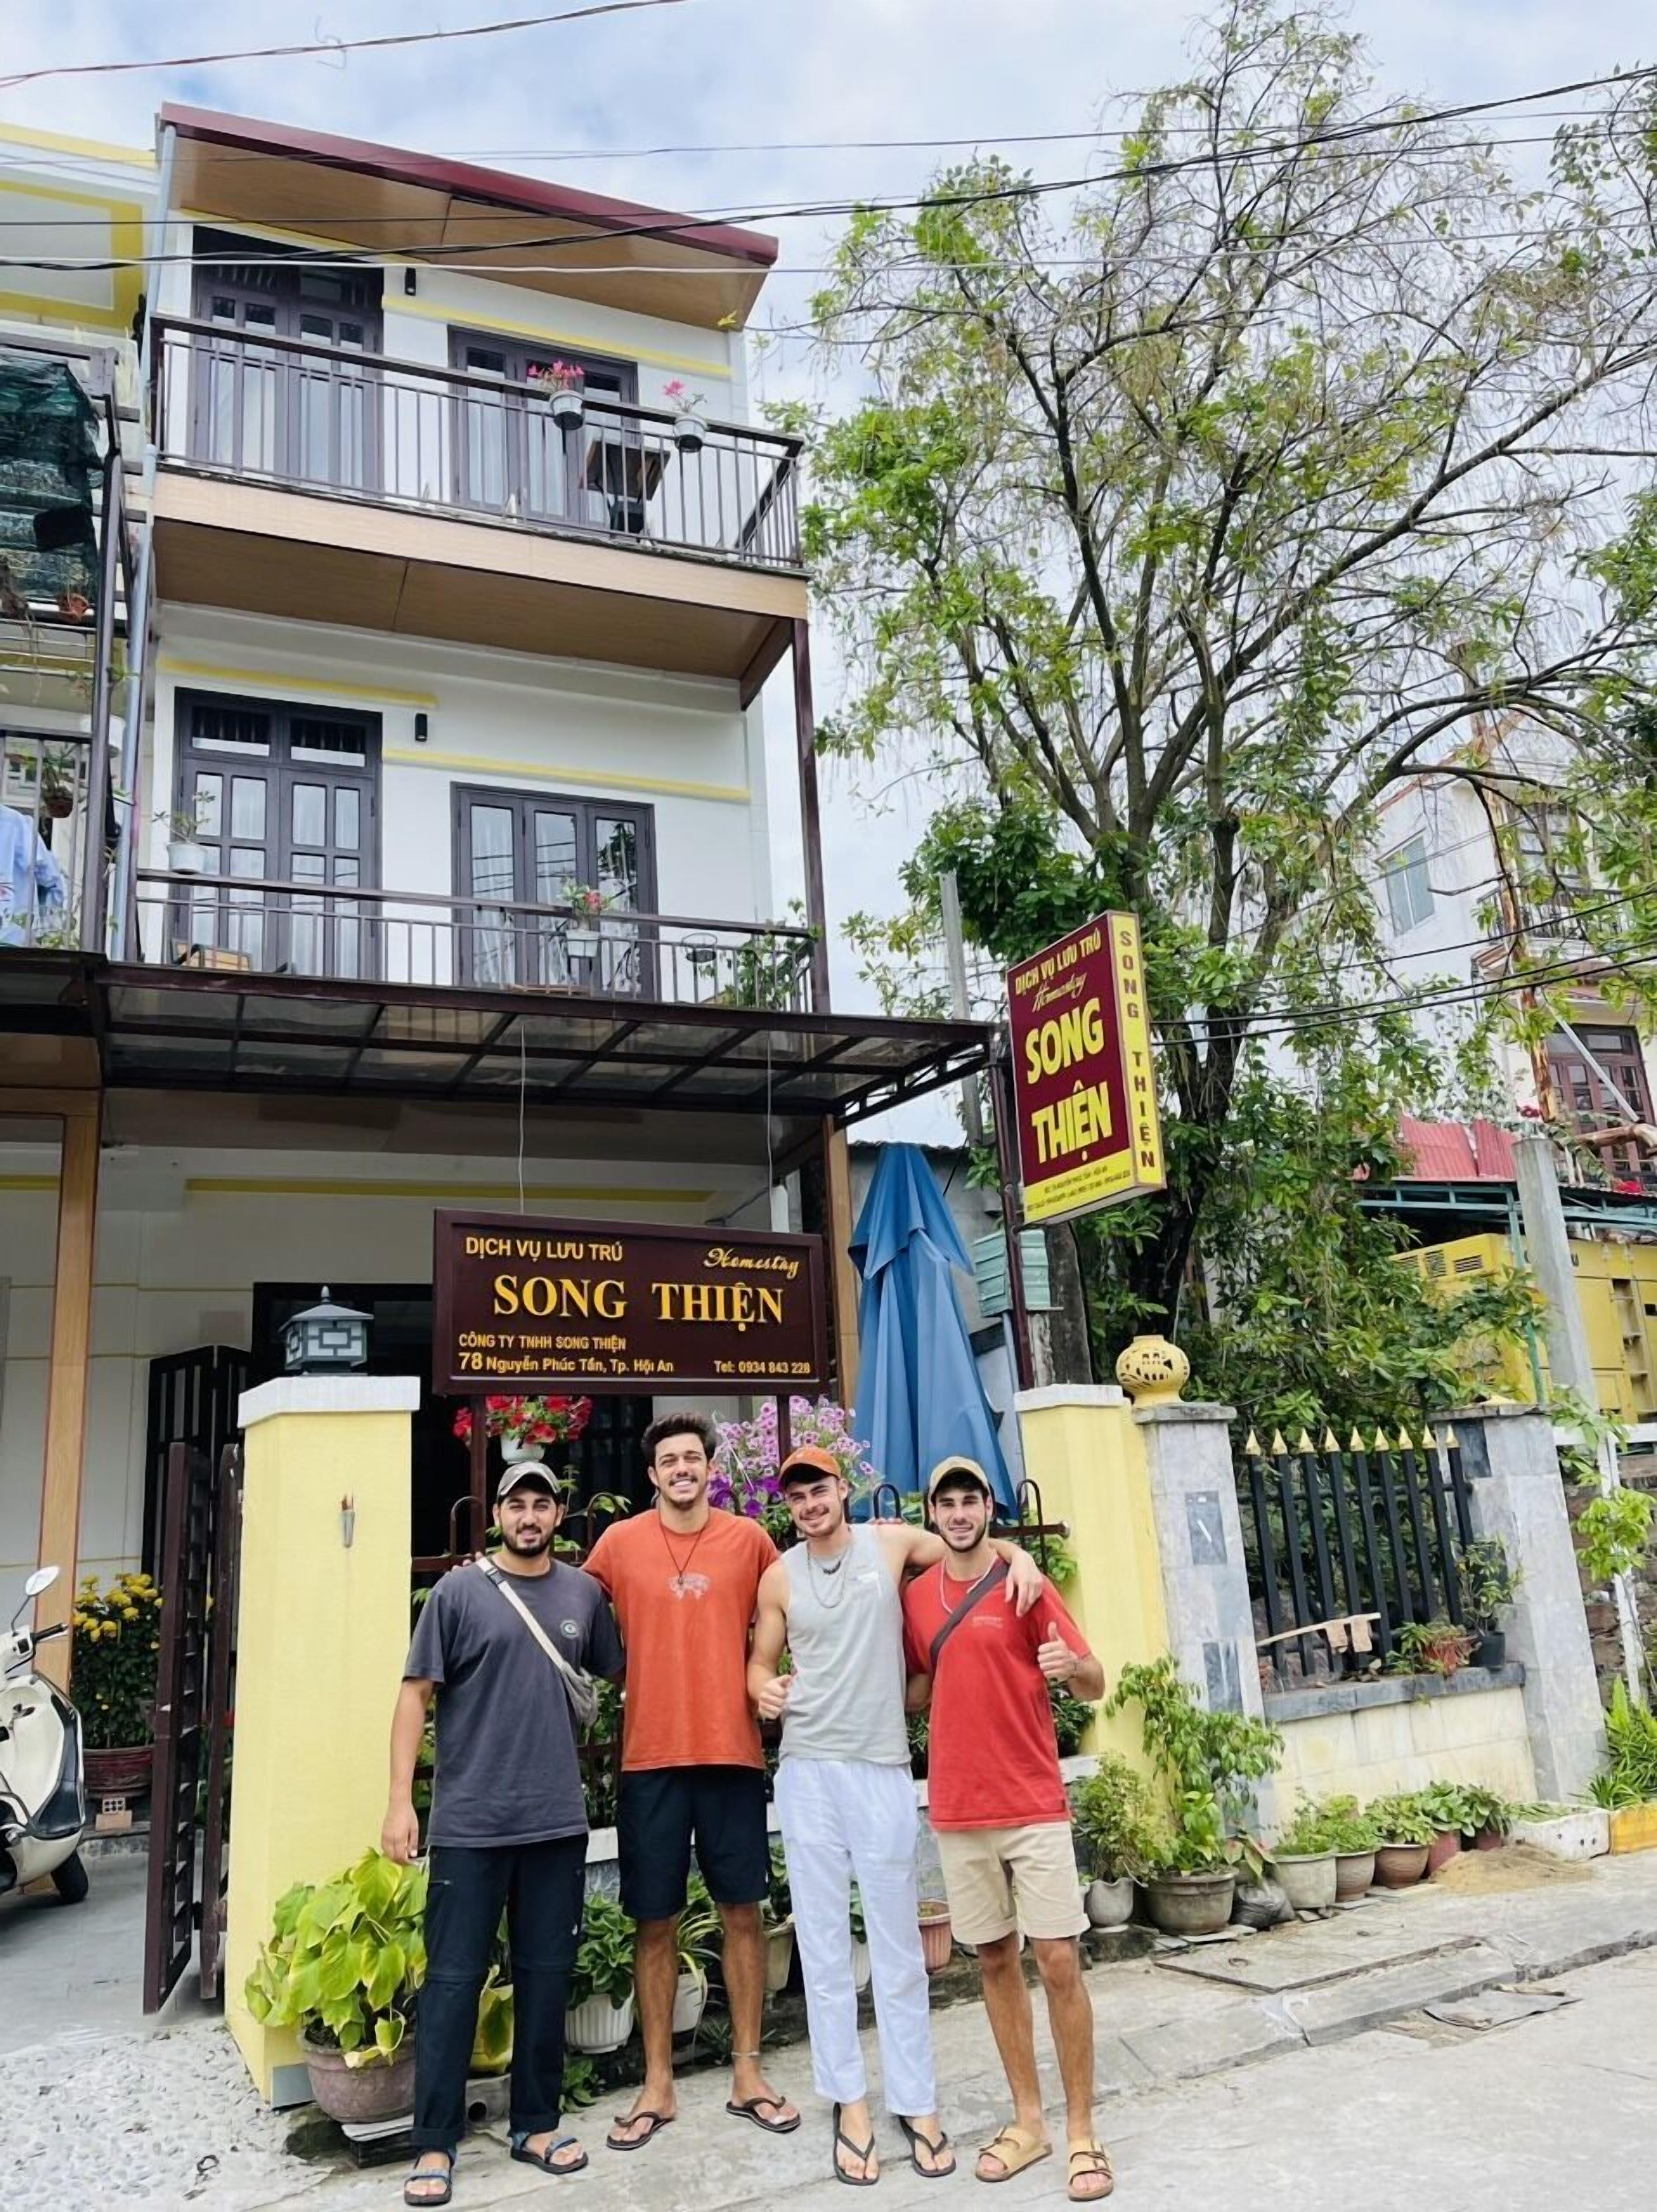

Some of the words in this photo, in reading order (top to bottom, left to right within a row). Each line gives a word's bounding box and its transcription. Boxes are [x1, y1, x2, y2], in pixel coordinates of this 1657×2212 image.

[1015, 966, 1039, 995] DỊCH
[1040, 956, 1055, 980] VỤ
[1025, 997, 1105, 1084] SONG
[1120, 930, 1139, 1018] SONG
[1132, 1051, 1155, 1167] THIỆN
[1031, 1080, 1112, 1164] THIỆN
[466, 1237, 511, 1259] DỊCH
[516, 1239, 541, 1262] VỤ
[546, 1241, 584, 1259] LƯU
[588, 1240, 623, 1262] TRÚ
[703, 1248, 800, 1279] Homestay
[494, 1274, 628, 1318] SONG
[651, 1282, 783, 1332] THIỆN
[459, 1331, 495, 1347] CÔNG
[498, 1335, 514, 1348] TY
[518, 1335, 552, 1349] TNHH
[556, 1336, 589, 1350] SONG
[591, 1335, 626, 1353] THIỆN
[458, 1352, 482, 1370] 78
[486, 1355, 538, 1373] Nguyễn
[543, 1357, 575, 1371] Phúc
[609, 1359, 629, 1374] Tp.
[634, 1359, 654, 1375] Hội
[657, 1359, 674, 1372] An
[738, 1361, 766, 1373] 0934
[791, 1362, 811, 1373] 228
